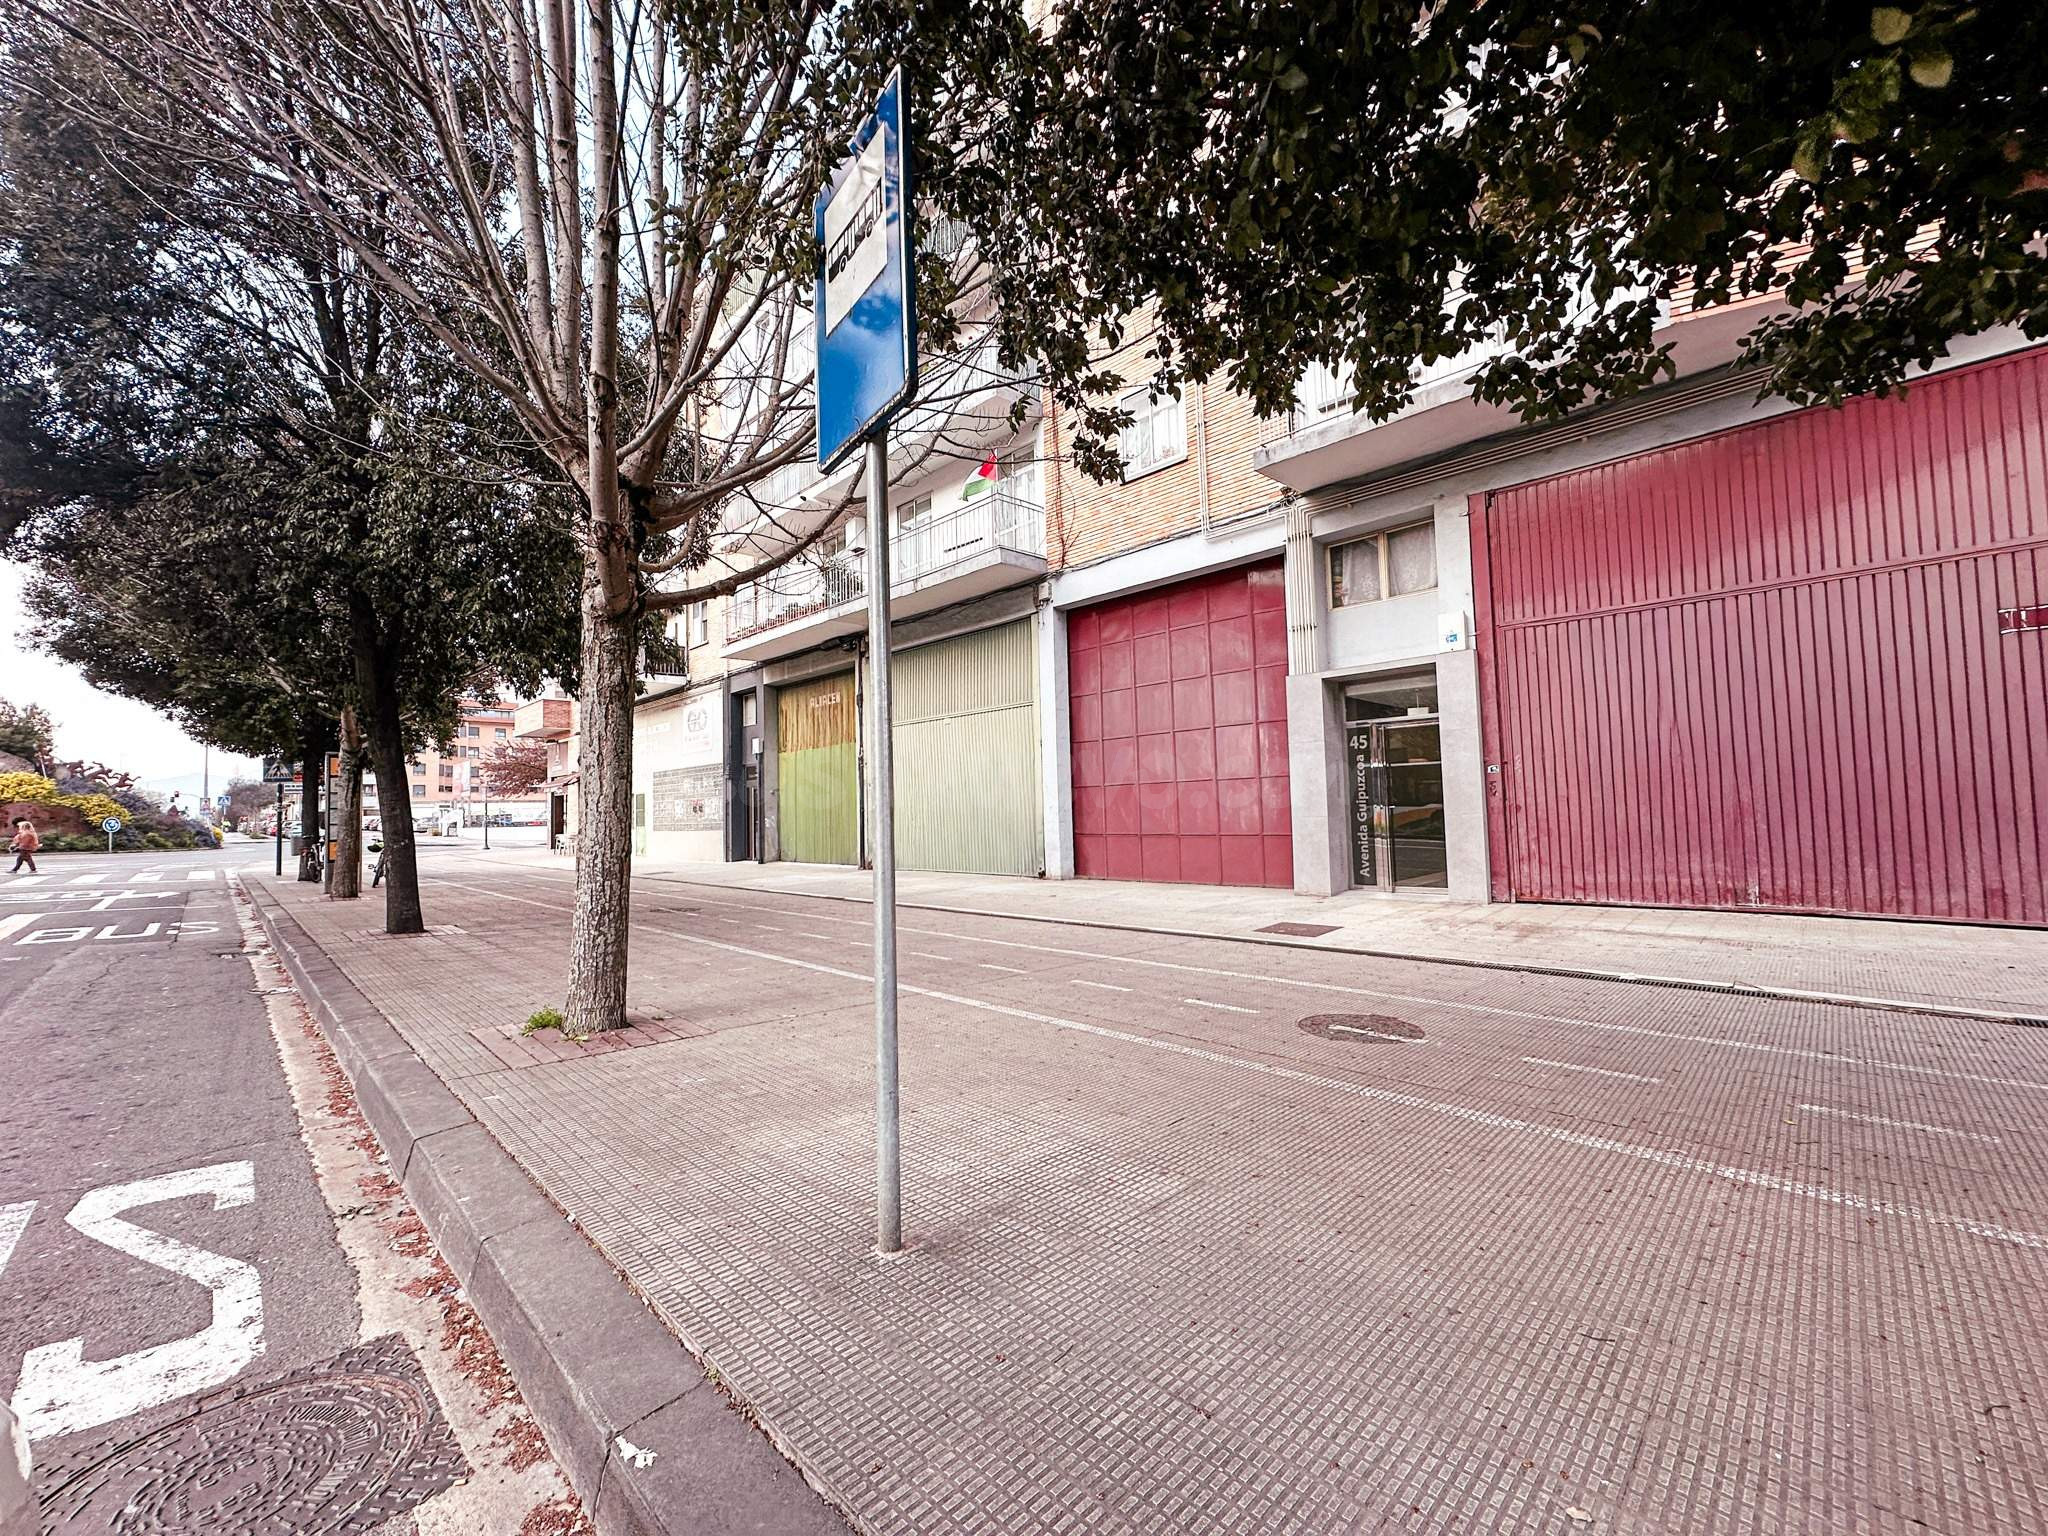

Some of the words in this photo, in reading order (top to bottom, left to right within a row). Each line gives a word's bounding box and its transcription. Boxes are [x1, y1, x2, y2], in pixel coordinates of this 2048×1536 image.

[1349, 735, 1368, 749] 45
[1356, 754, 1369, 822] Guipuzcoa
[1358, 824, 1370, 877] Avenida
[12, 921, 220, 946] BUS
